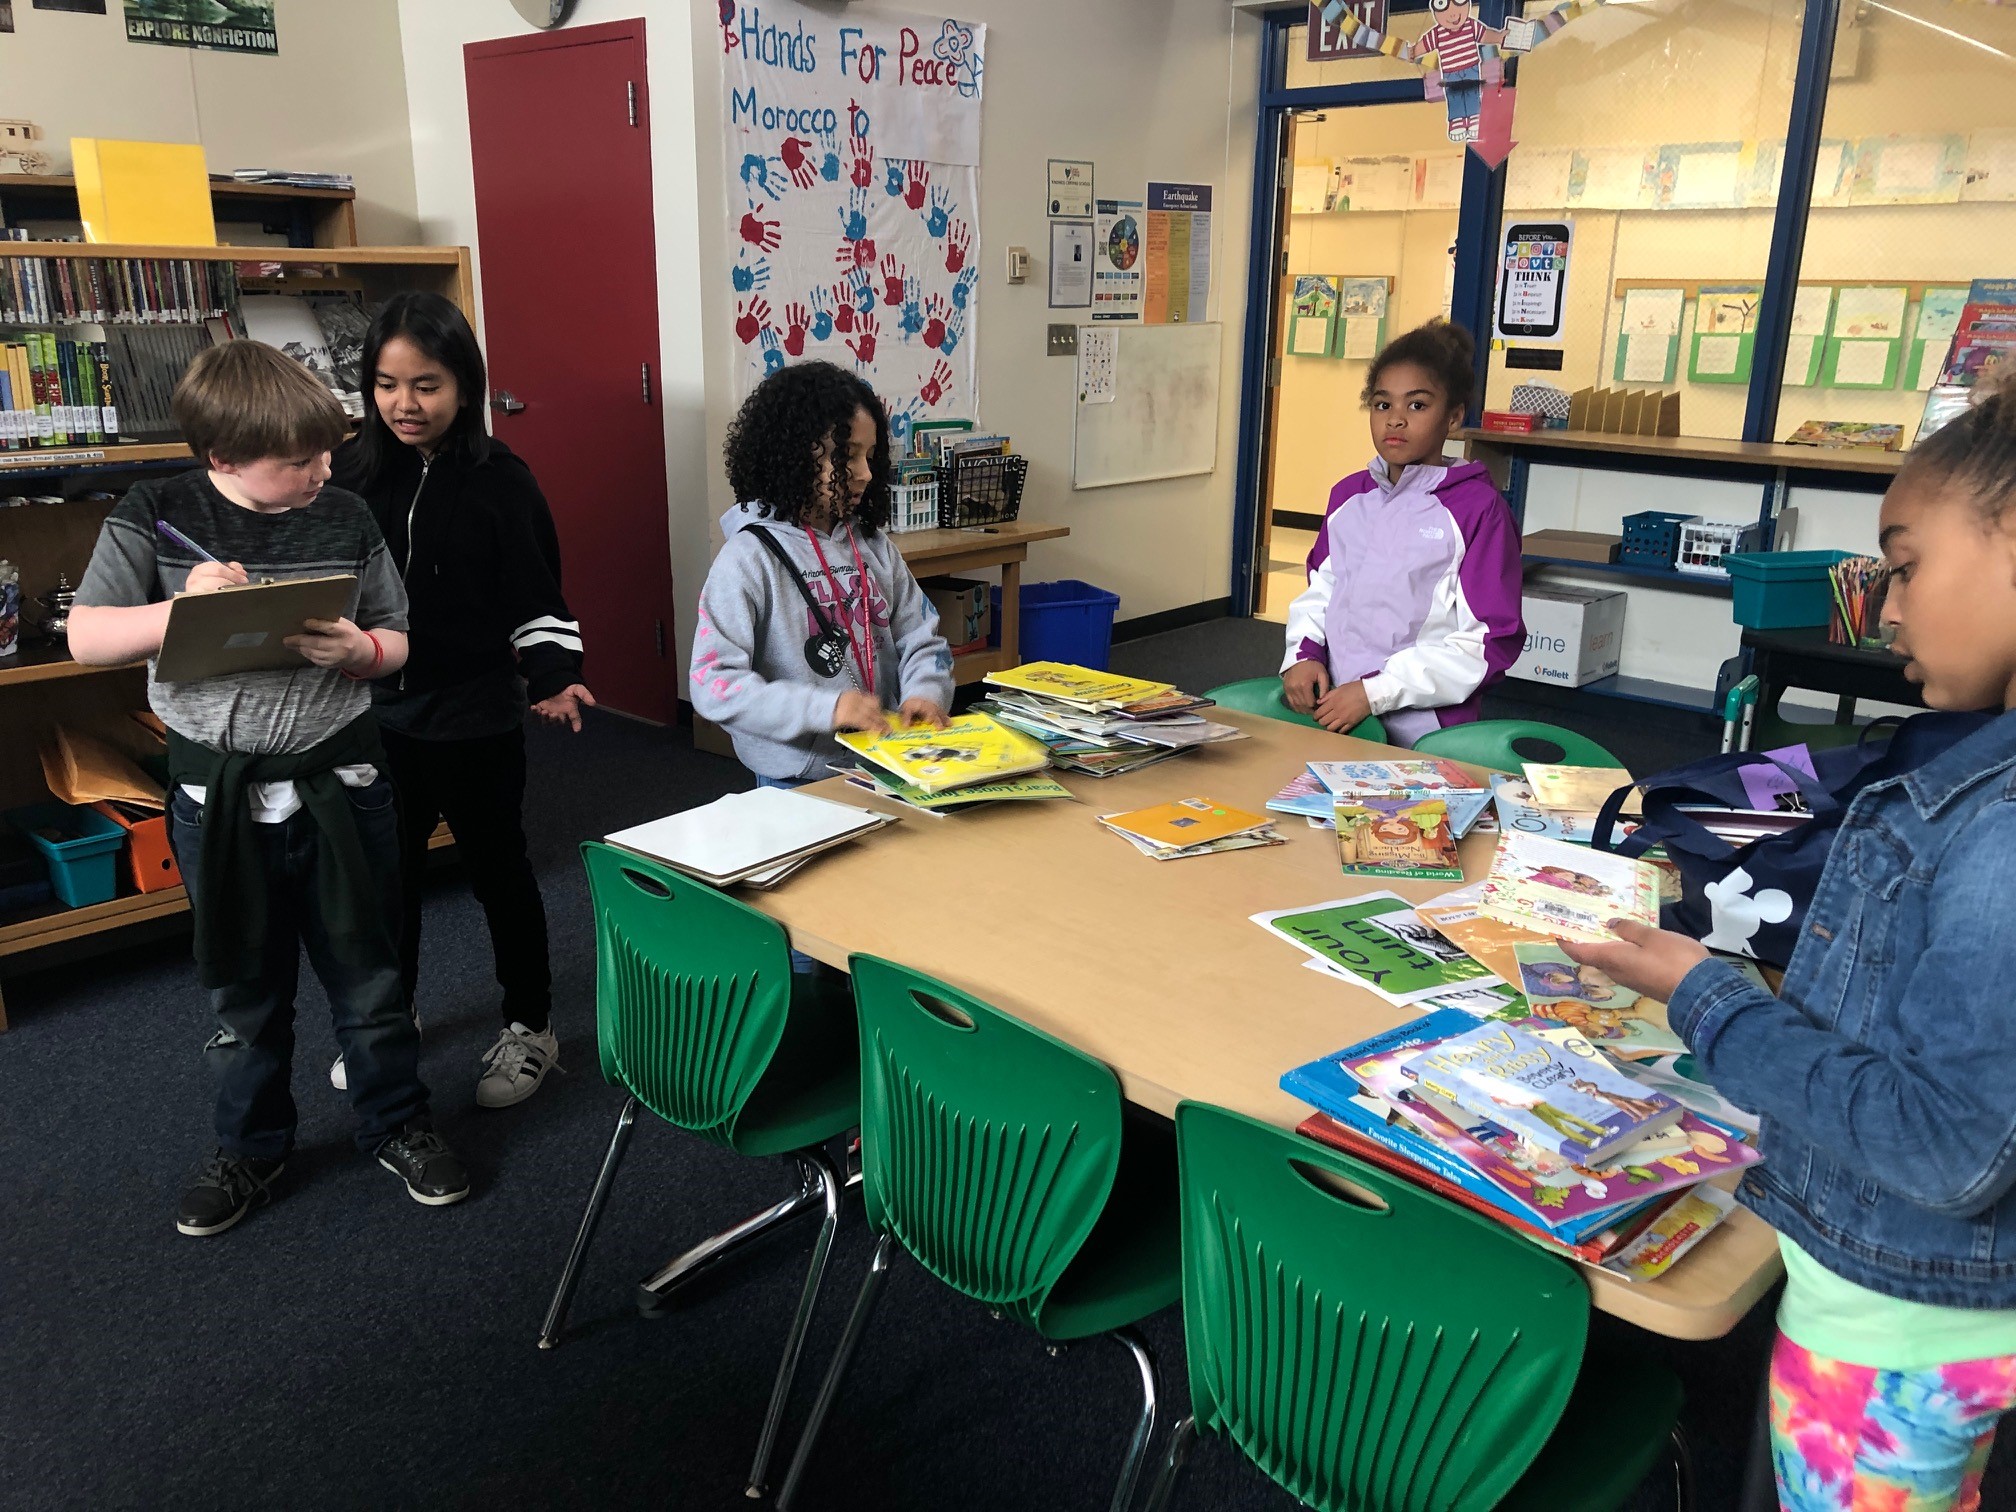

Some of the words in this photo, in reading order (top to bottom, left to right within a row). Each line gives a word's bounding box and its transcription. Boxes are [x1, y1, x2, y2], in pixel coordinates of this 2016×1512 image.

[128, 20, 190, 40] EXPLORE
[192, 25, 276, 49] NONFICTION
[740, 7, 816, 73] Hands
[838, 28, 887, 83] For
[899, 27, 957, 86] Peace
[732, 86, 837, 134] Morocco
[847, 98, 870, 138] to
[1163, 190, 1198, 204] Earthquake
[1515, 272, 1552, 282] THINK
[1522, 630, 1565, 652] gine
[1590, 632, 1614, 652] learn
[1542, 668, 1569, 680] Follett
[914, 790, 960, 802] Tooth
[966, 784, 1012, 795] Loose
[1014, 784, 1063, 794] Bear's
[1375, 869, 1412, 877] Reading
[1292, 926, 1392, 984] Your
[1342, 920, 1434, 970] turn
[1346, 1046, 1370, 1058] Rand
[1424, 1030, 1515, 1074] Henry
[1485, 1046, 1551, 1080] Ribsy
[1516, 1062, 1564, 1083] Beverly
[1532, 1067, 1575, 1089] Cleary
[1318, 1102, 1330, 1110] Rand
[1368, 1126, 1398, 1150] Favorite
[1399, 1144, 1441, 1174] Sleepytime
[1442, 1167, 1461, 1185] Tales
